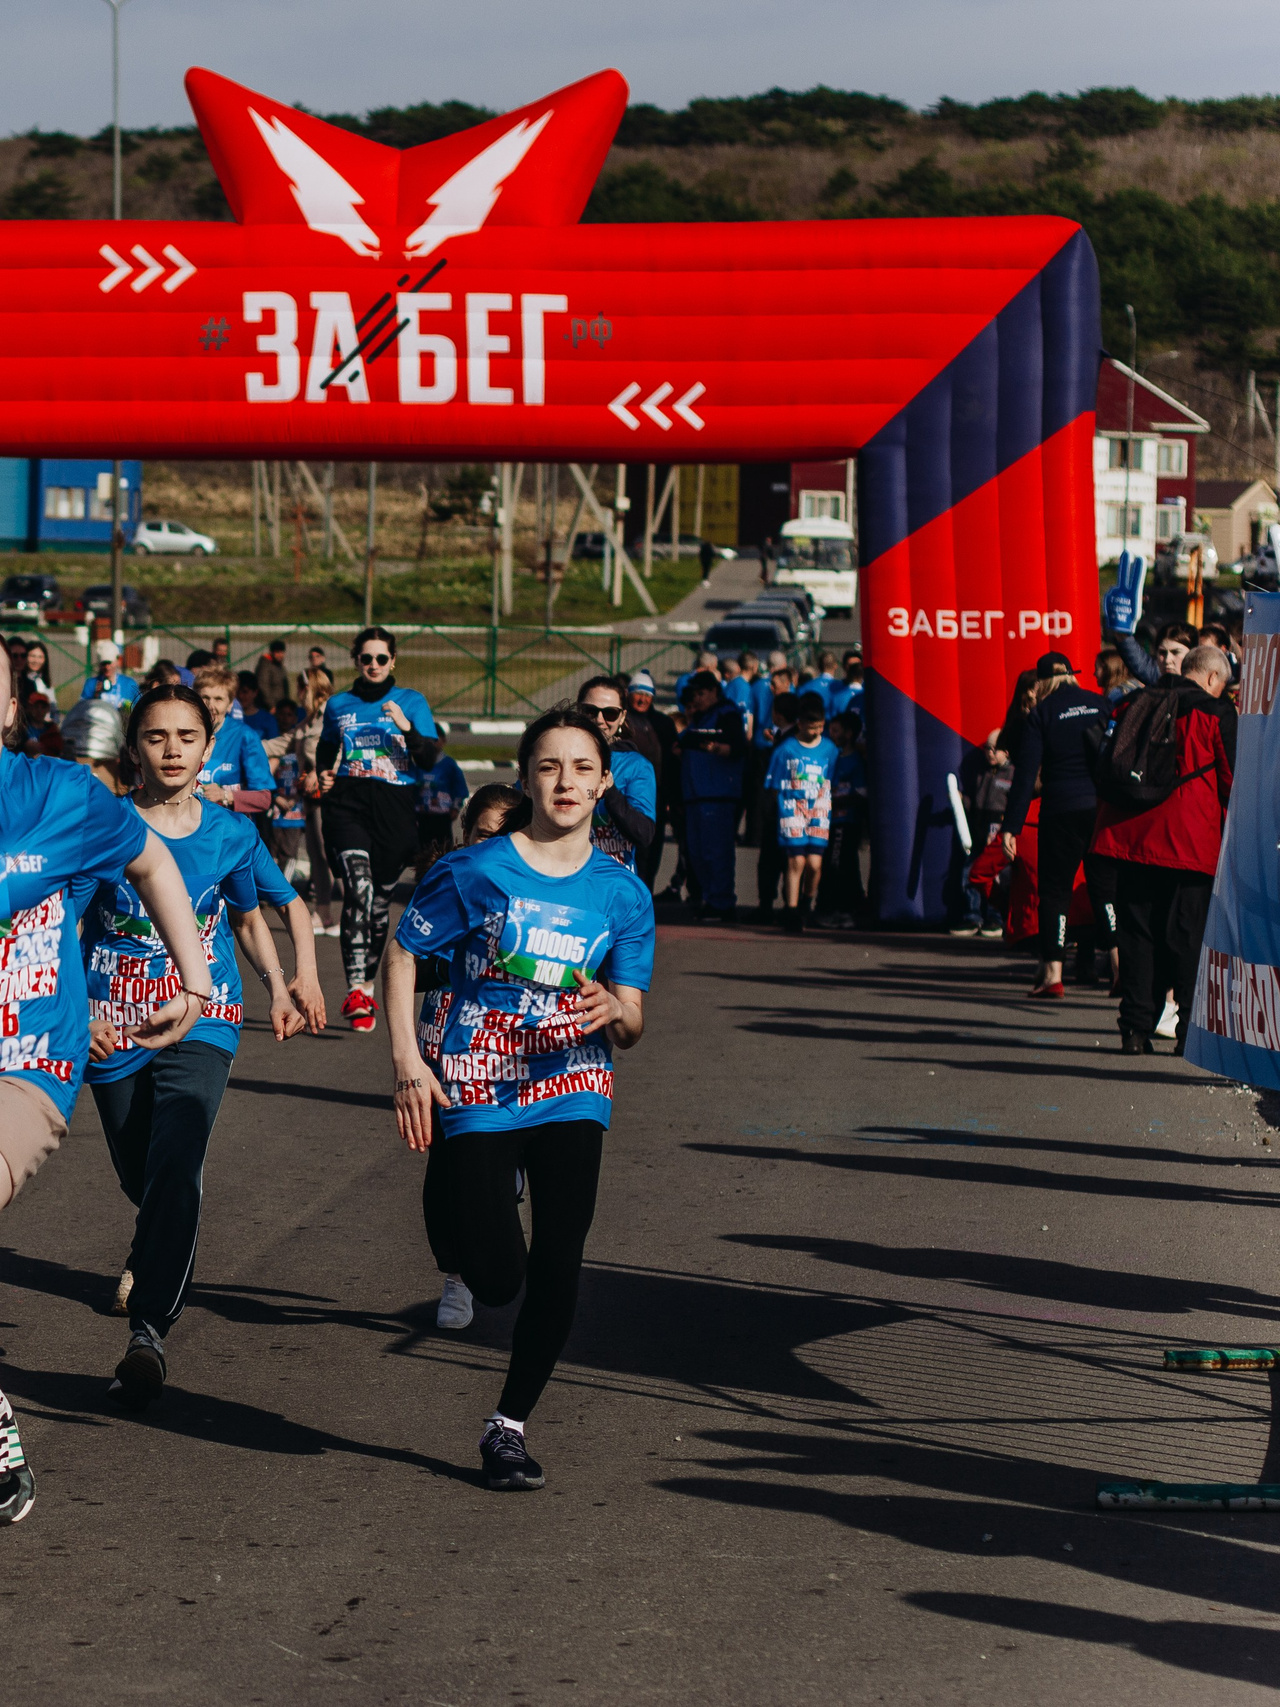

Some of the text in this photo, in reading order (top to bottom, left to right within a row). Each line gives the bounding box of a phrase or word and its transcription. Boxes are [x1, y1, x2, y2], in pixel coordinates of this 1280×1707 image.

[887, 607, 1073, 639] ЗАБЕГ.РФ
[407, 907, 434, 936] ПСБ
[525, 927, 587, 963] 10005
